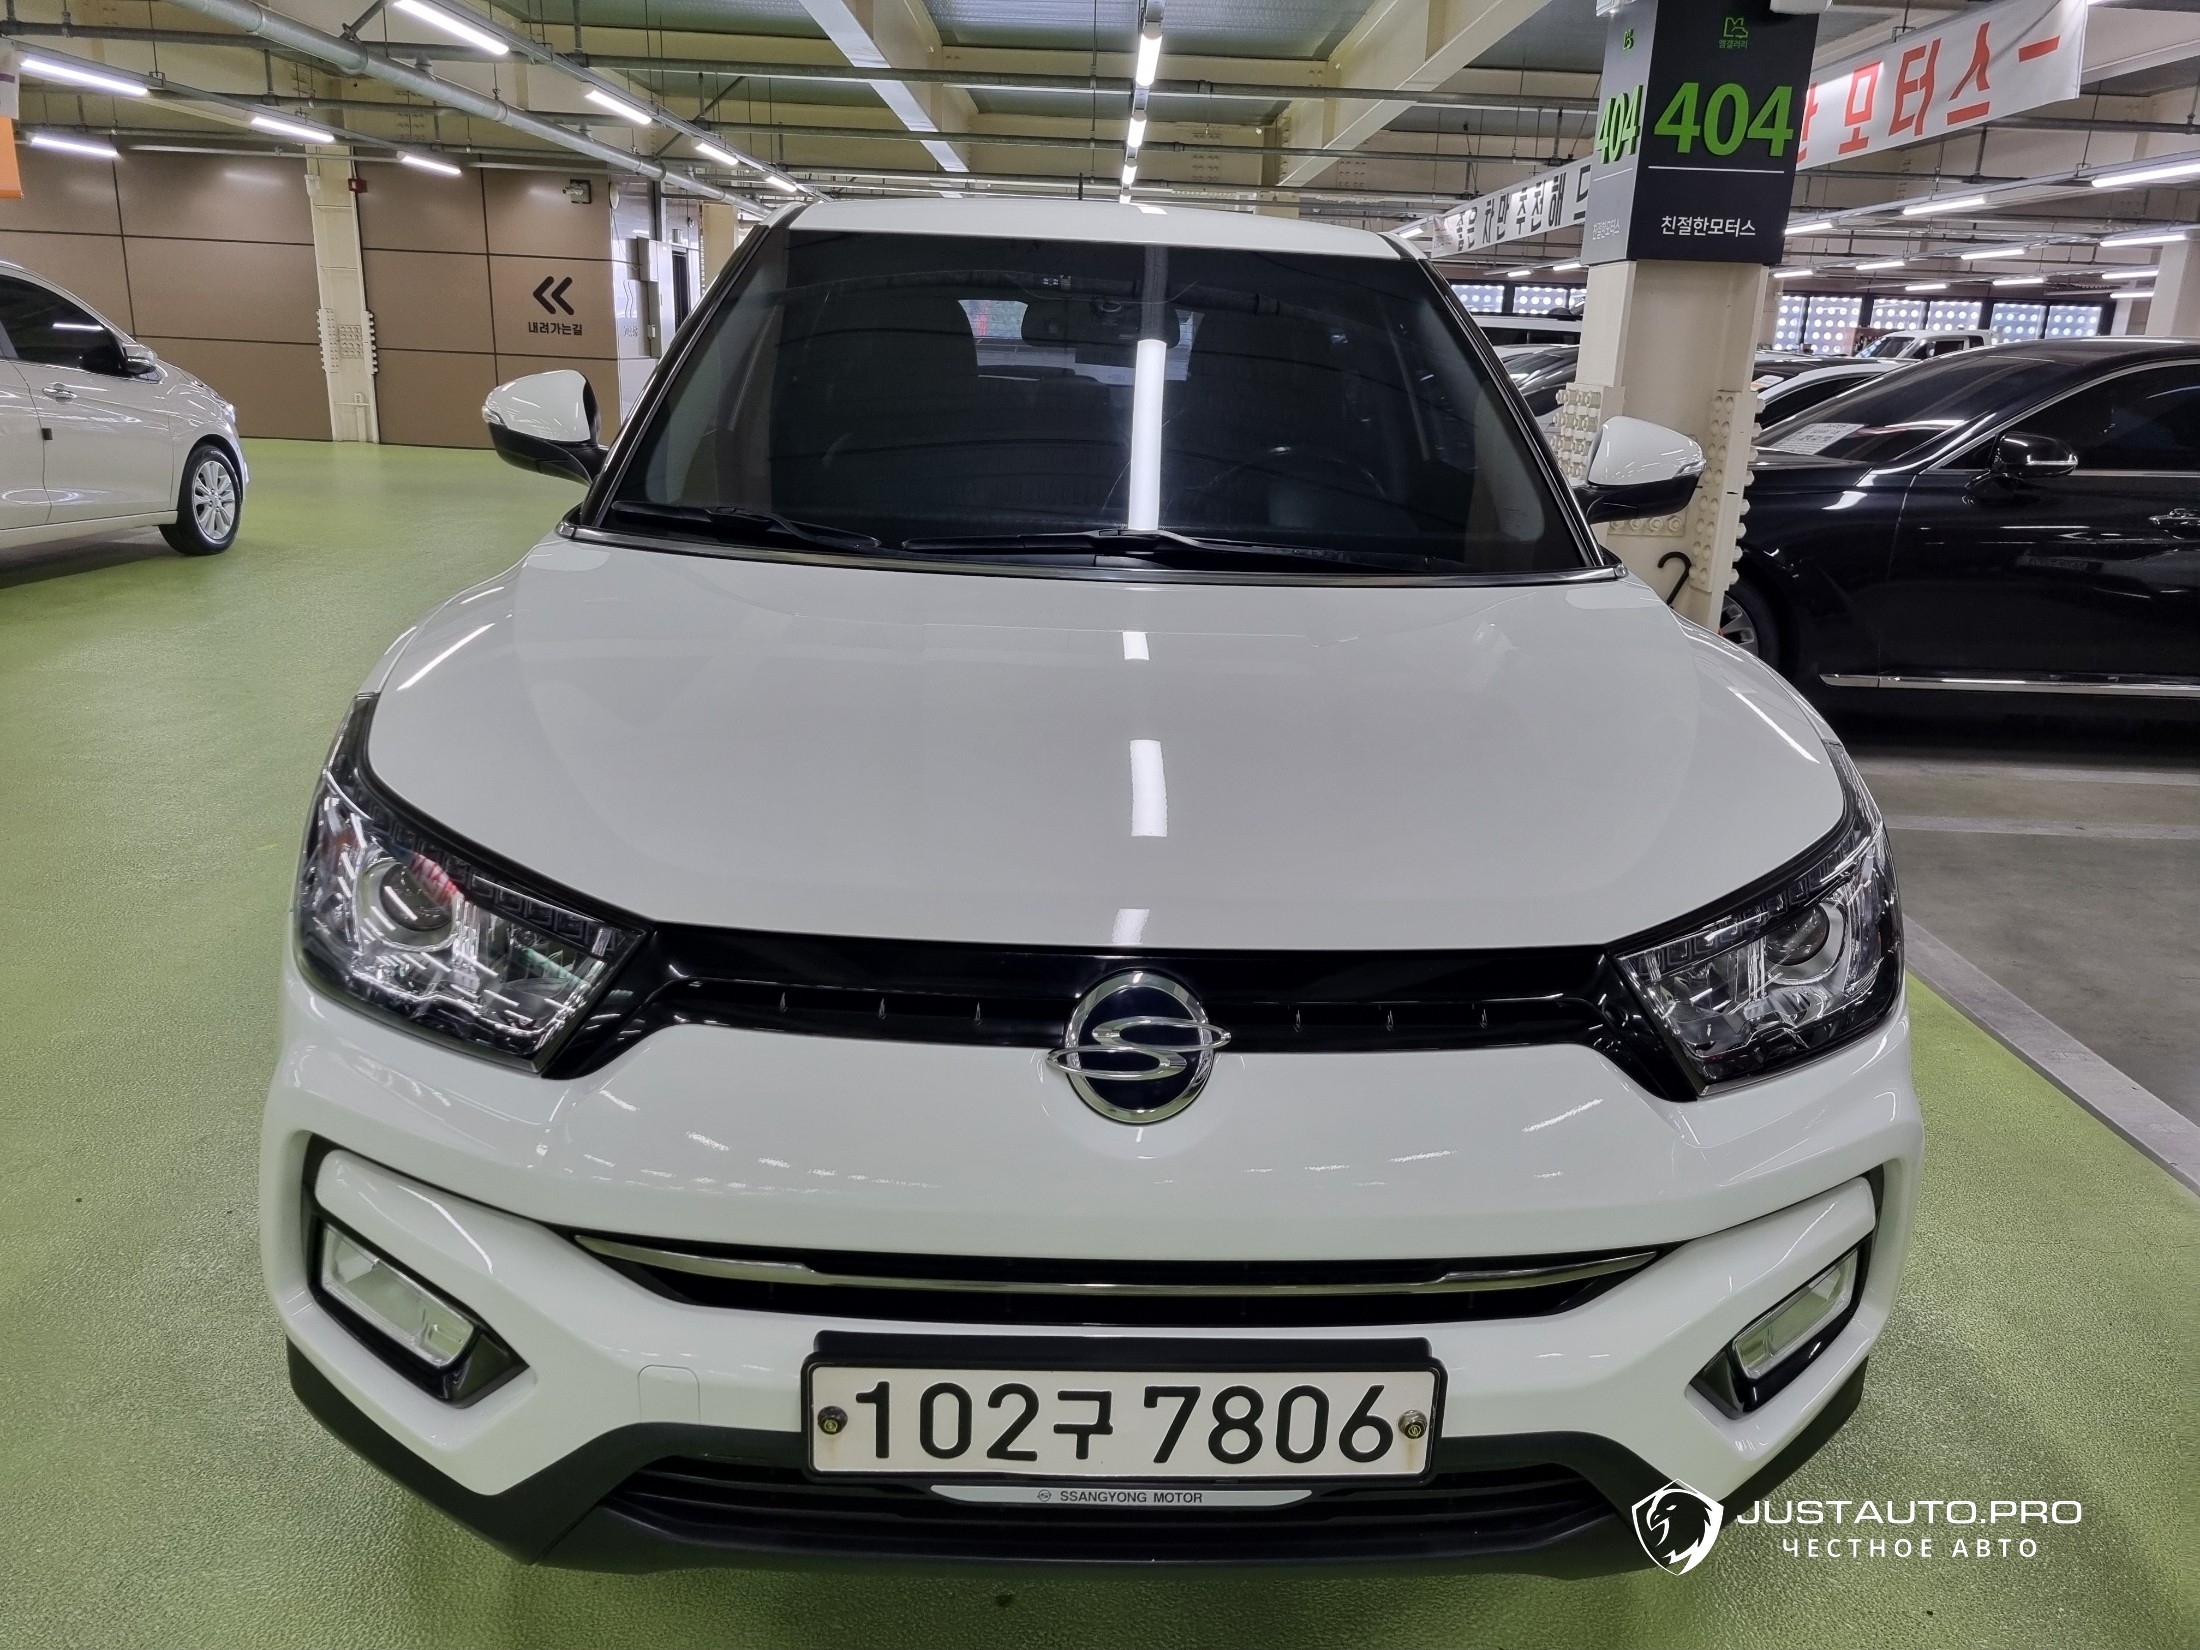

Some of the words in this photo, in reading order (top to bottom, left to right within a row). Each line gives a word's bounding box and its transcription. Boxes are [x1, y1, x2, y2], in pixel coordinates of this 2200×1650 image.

[1596, 84, 1644, 164] 404
[1654, 82, 1794, 157] 404
[1456, 206, 1477, 252] 좋은
[1516, 172, 1567, 235] 추천해
[1660, 215, 1756, 238] 친절한모터스
[528, 321, 583, 336] 내려가는길
[855, 1380, 1114, 1462] 102구
[1143, 1384, 1394, 1465] 7806
[1059, 1489, 1147, 1504] SSANGYONG
[1153, 1491, 1203, 1505] MOTOR
